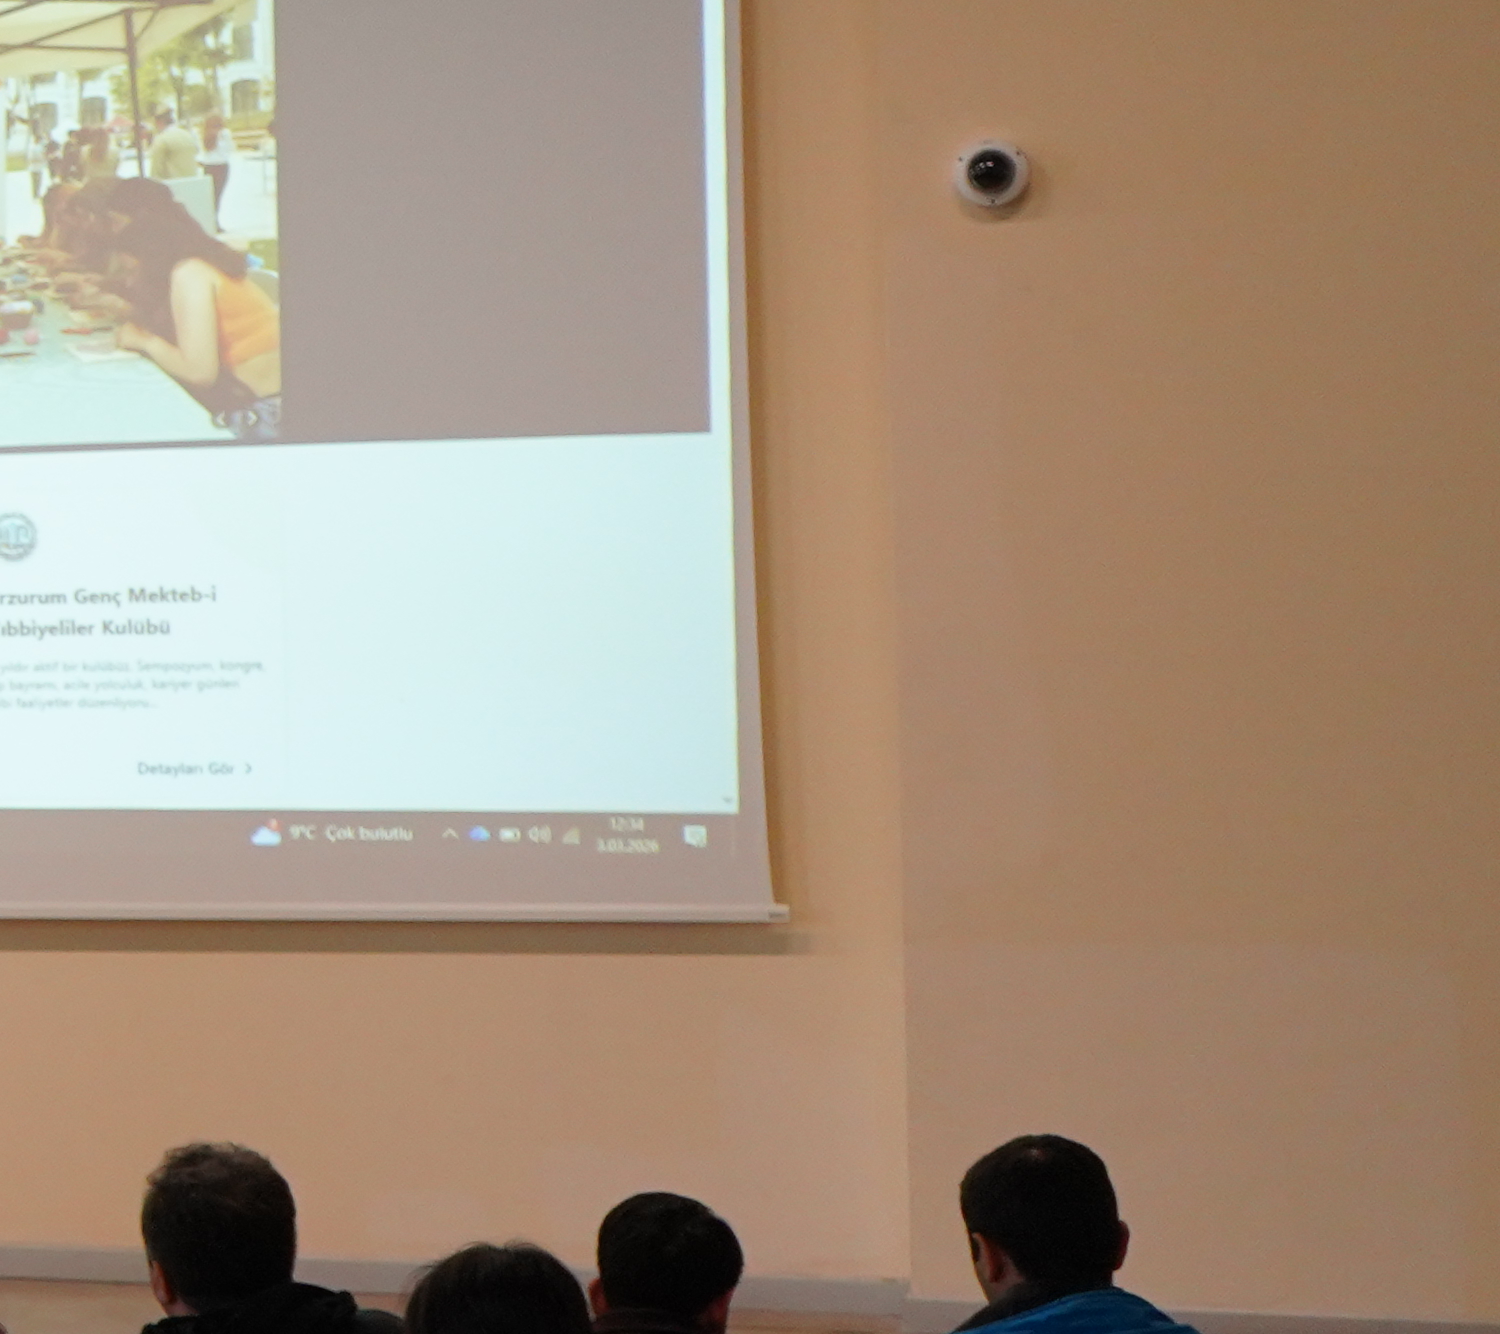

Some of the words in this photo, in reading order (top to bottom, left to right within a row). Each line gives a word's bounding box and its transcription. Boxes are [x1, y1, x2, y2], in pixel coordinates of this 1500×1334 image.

[73, 588, 121, 608] Genç
[127, 586, 216, 603] Mekteb-i
[101, 618, 170, 635] Kulübü
[208, 762, 234, 775] Gör
[289, 825, 315, 840] 9°C
[324, 825, 355, 843] Çok
[358, 826, 413, 841] bulutlu
